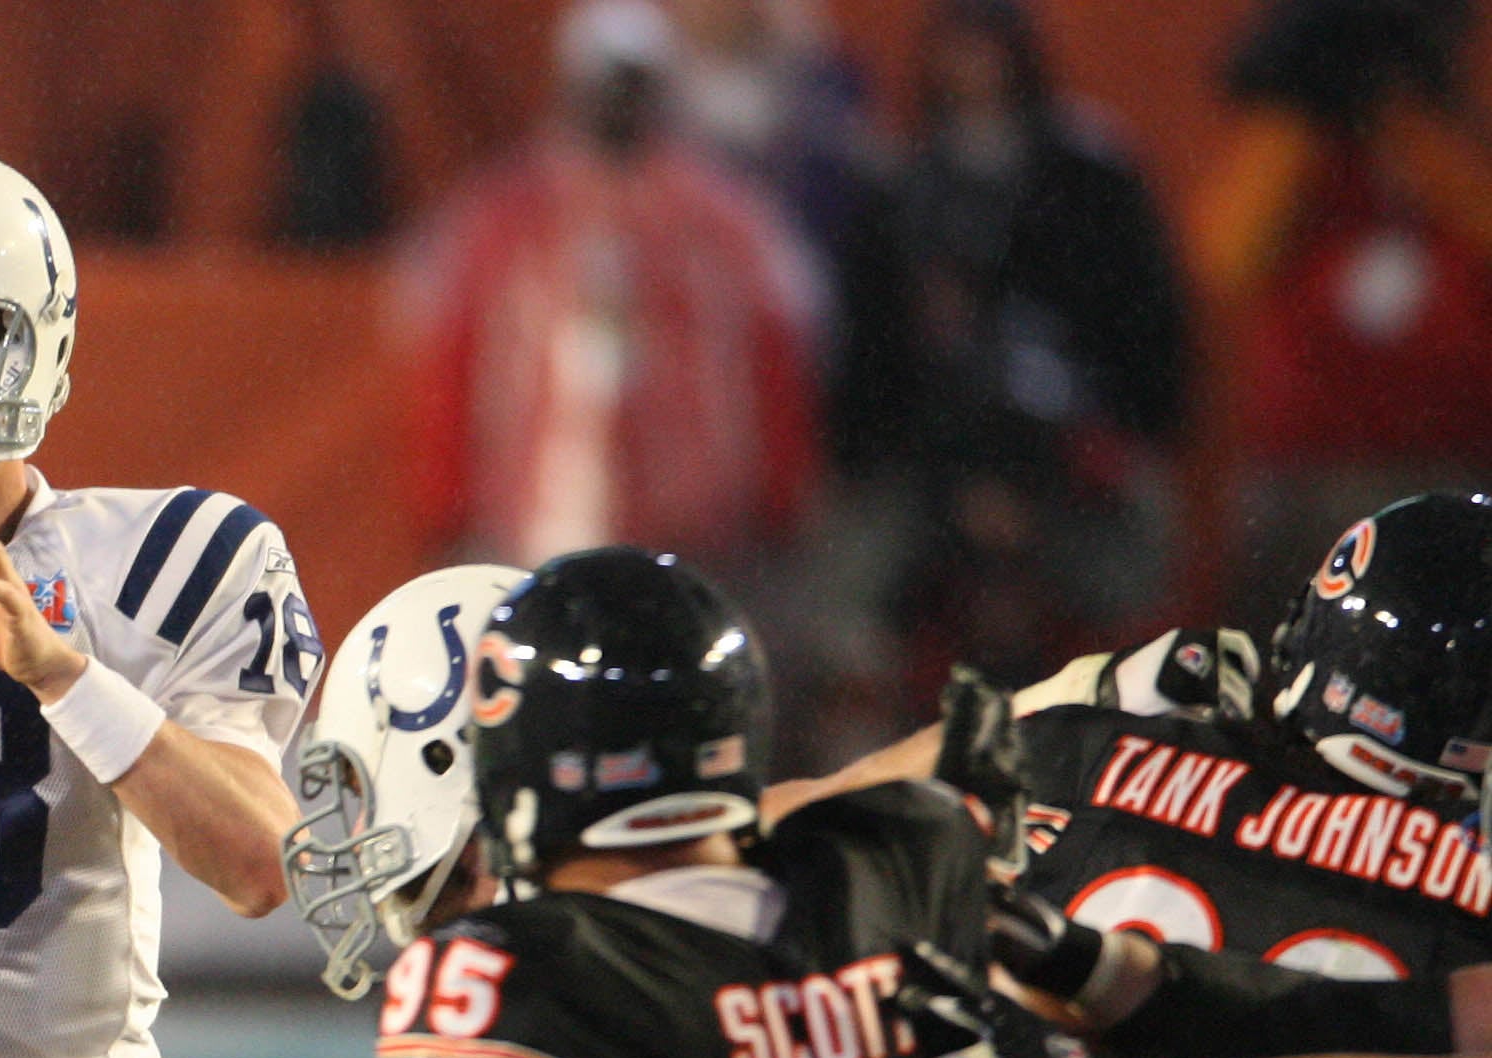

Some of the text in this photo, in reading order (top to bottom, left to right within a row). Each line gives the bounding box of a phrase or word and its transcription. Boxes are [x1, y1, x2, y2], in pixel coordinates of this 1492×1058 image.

[238, 591, 325, 699] 18
[1092, 734, 1252, 838] TANK
[1235, 784, 1492, 917] JOHNSON
[379, 935, 515, 1040] 95
